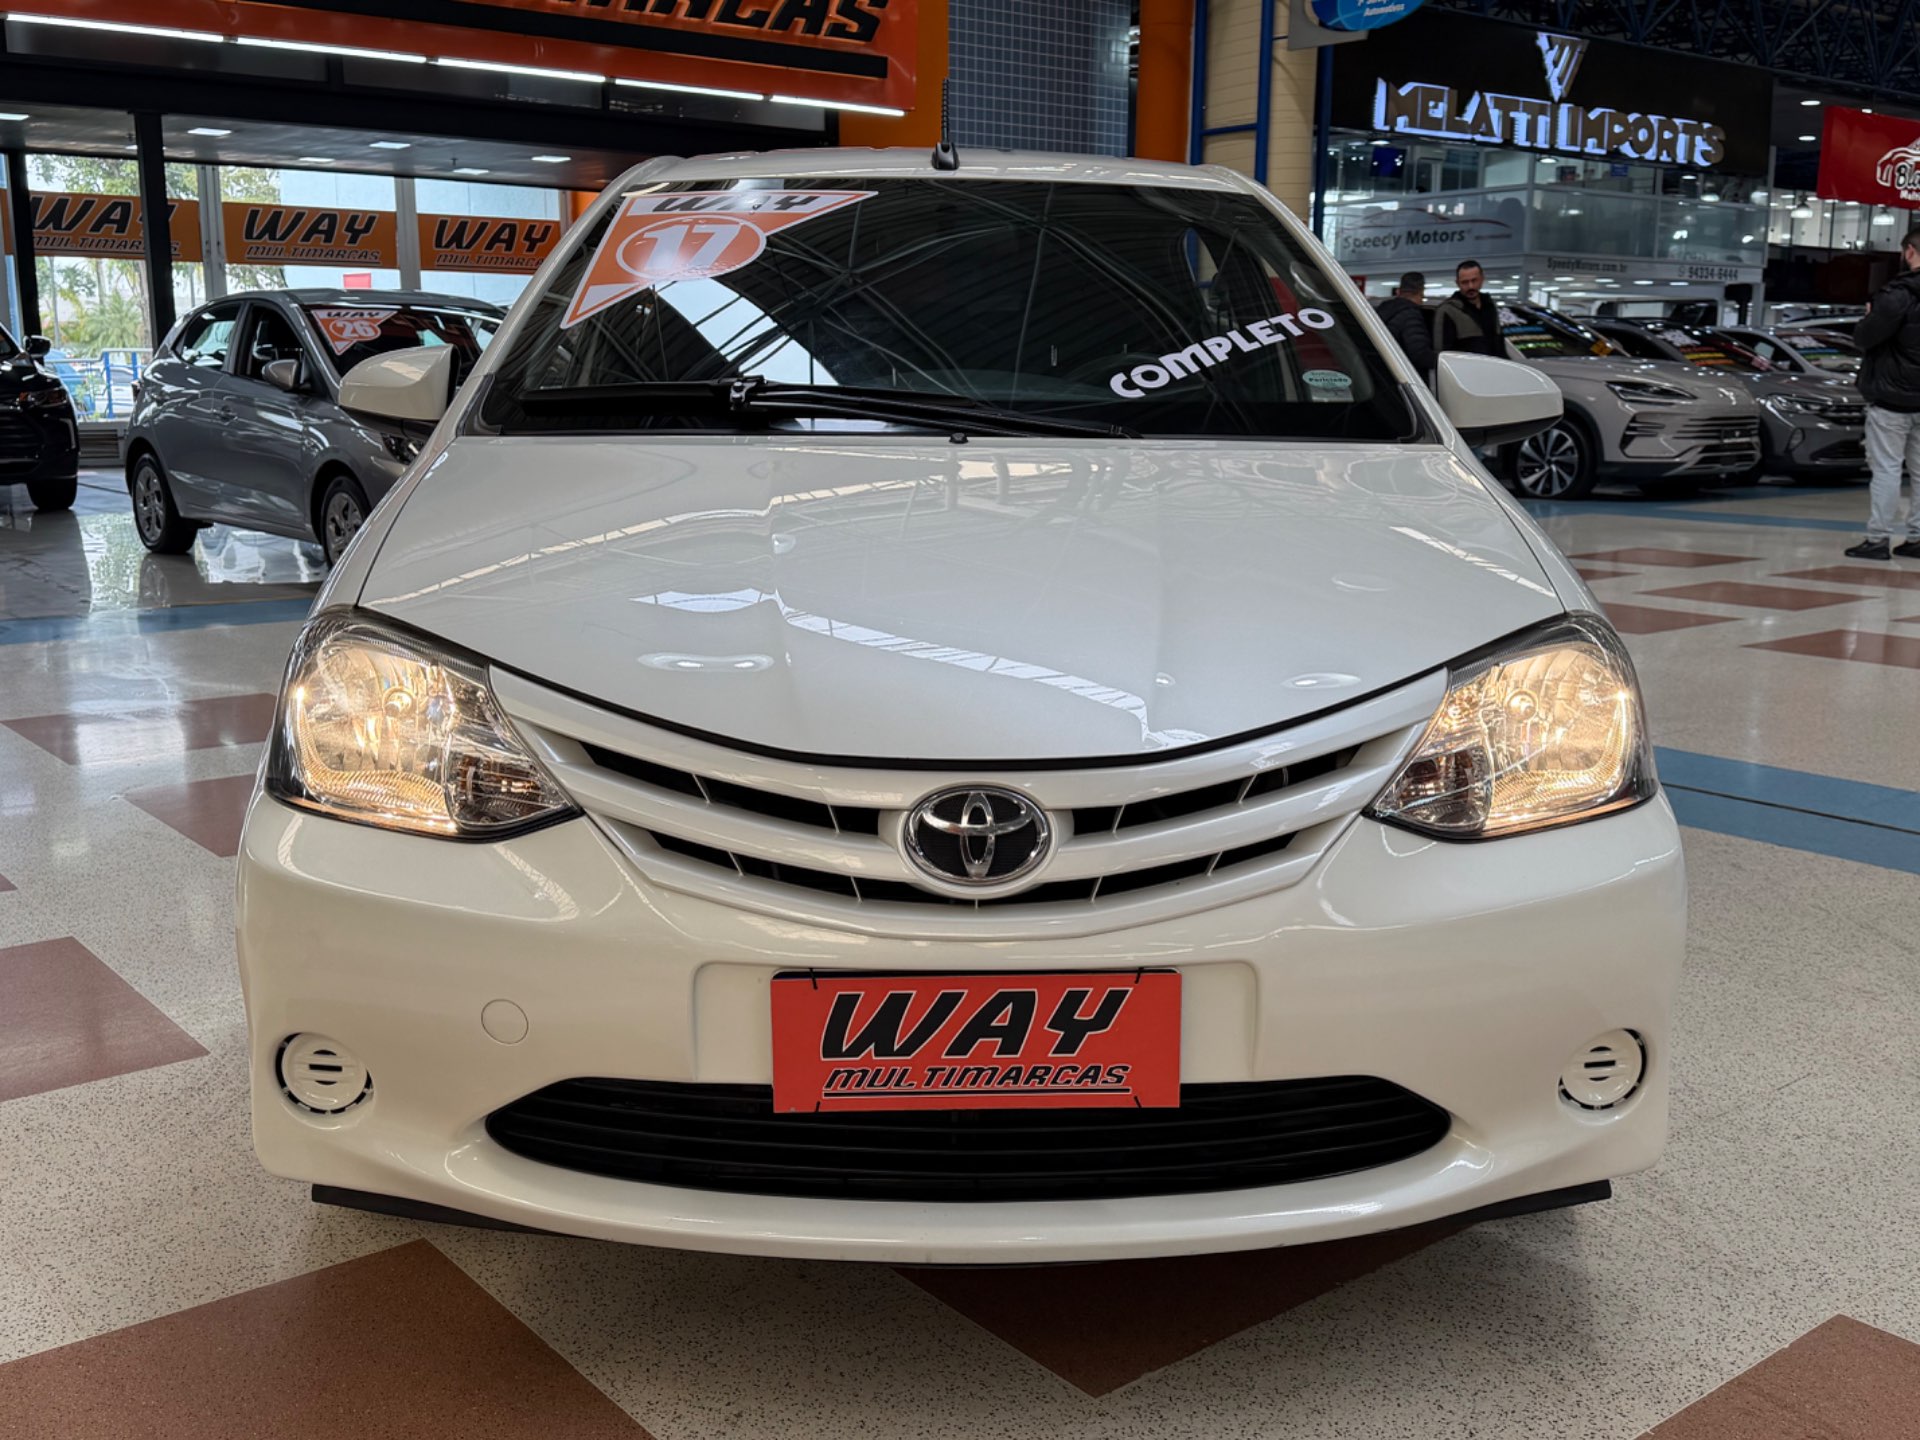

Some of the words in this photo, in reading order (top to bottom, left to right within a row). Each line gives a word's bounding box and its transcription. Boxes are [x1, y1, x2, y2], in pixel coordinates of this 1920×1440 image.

[1557, 103, 1727, 167] IMPORTS
[30, 194, 179, 236] WA
[653, 195, 821, 213] WAY
[243, 207, 379, 246] WAY
[433, 218, 552, 254] WAY
[1343, 232, 1402, 254] Speedy
[1405, 229, 1466, 246] Motors
[33, 236, 181, 251] MULTIMARS
[246, 245, 381, 261] MULTIMARCAS
[643, 223, 744, 269] 17
[327, 310, 380, 319] WAY
[335, 320, 376, 338] 26
[1109, 307, 1335, 399] COMPLETO
[820, 987, 1133, 1062] WAY
[824, 1064, 1132, 1091] MULTIMARCAS
